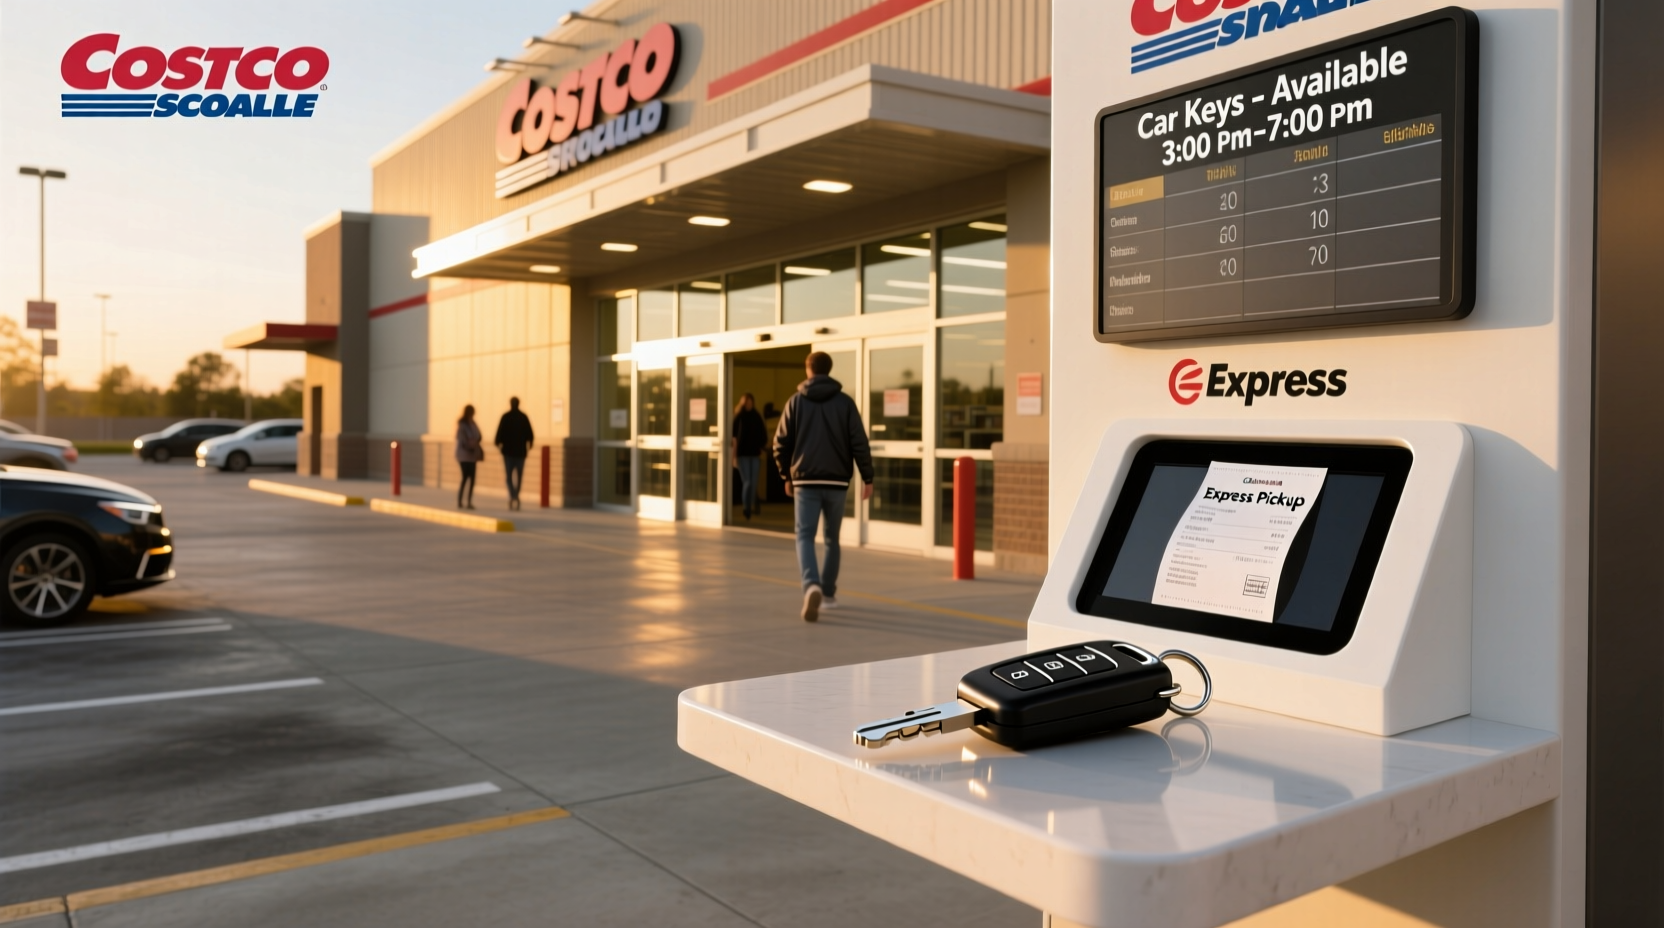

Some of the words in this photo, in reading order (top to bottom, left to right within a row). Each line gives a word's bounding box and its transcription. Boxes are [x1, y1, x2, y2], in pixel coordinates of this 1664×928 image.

[495, 22, 675, 165] COSTCO
[1137, 110, 1179, 140] Car
[1184, 93, 1245, 128] Keys
[1270, 46, 1408, 106] Available
[1161, 131, 1211, 166] 3:00
[1330, 97, 1373, 128] Pm
[1309, 208, 1329, 230] 10
[1206, 363, 1348, 407] Express
[1203, 487, 1254, 504] Express
[1256, 490, 1305, 512] Pickup
